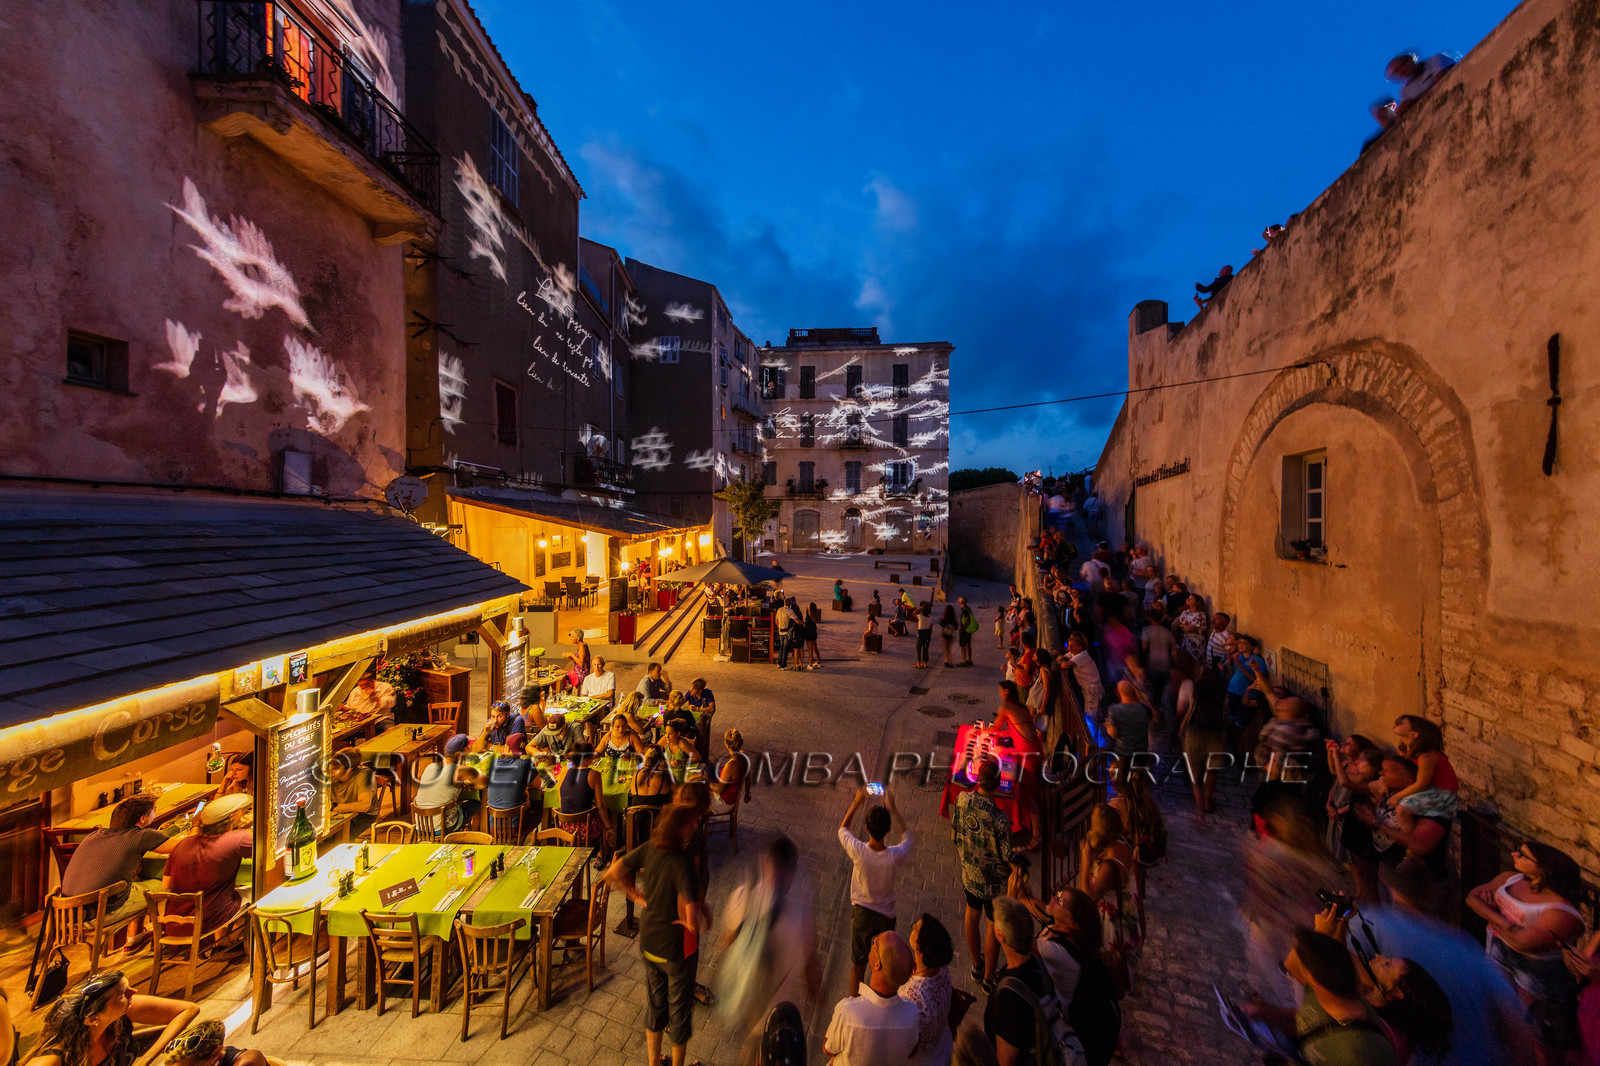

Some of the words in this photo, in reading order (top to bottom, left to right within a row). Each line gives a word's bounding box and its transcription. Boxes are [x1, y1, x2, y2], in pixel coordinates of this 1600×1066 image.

[281, 720, 321, 742] SPÉCIALITÉS
[284, 740, 295, 750] DU
[298, 732, 315, 744] CHEF
[0, 749, 65, 793] ge
[93, 703, 207, 761] Corse
